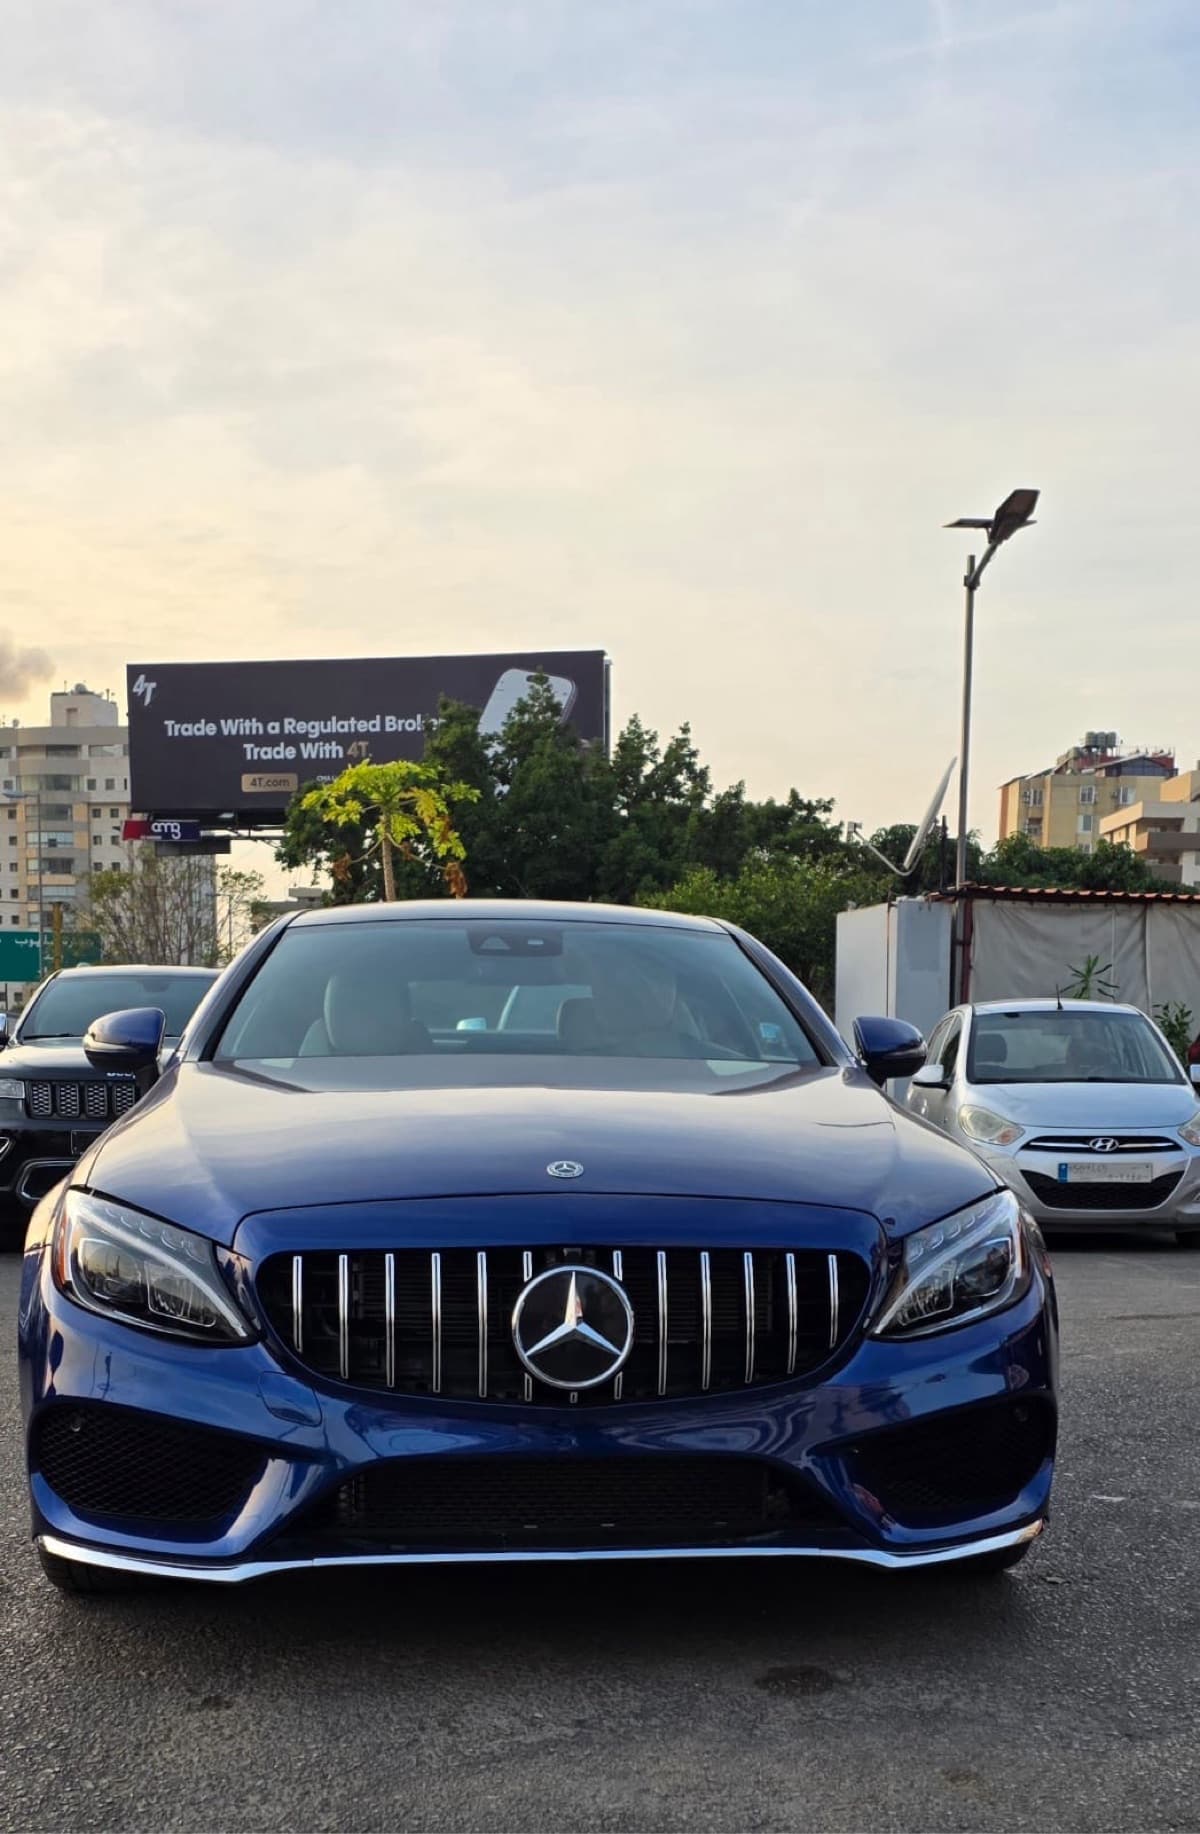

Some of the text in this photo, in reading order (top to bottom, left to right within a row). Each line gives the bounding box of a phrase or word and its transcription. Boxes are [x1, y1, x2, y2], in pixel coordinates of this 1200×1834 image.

[132, 674, 157, 706] 4T
[164, 718, 217, 736] Trade
[220, 718, 263, 735] With
[267, 721, 280, 734] a
[283, 714, 380, 738] Regulated
[243, 740, 373, 760] Trade With 4T.
[250, 777, 290, 788] 4T.com
